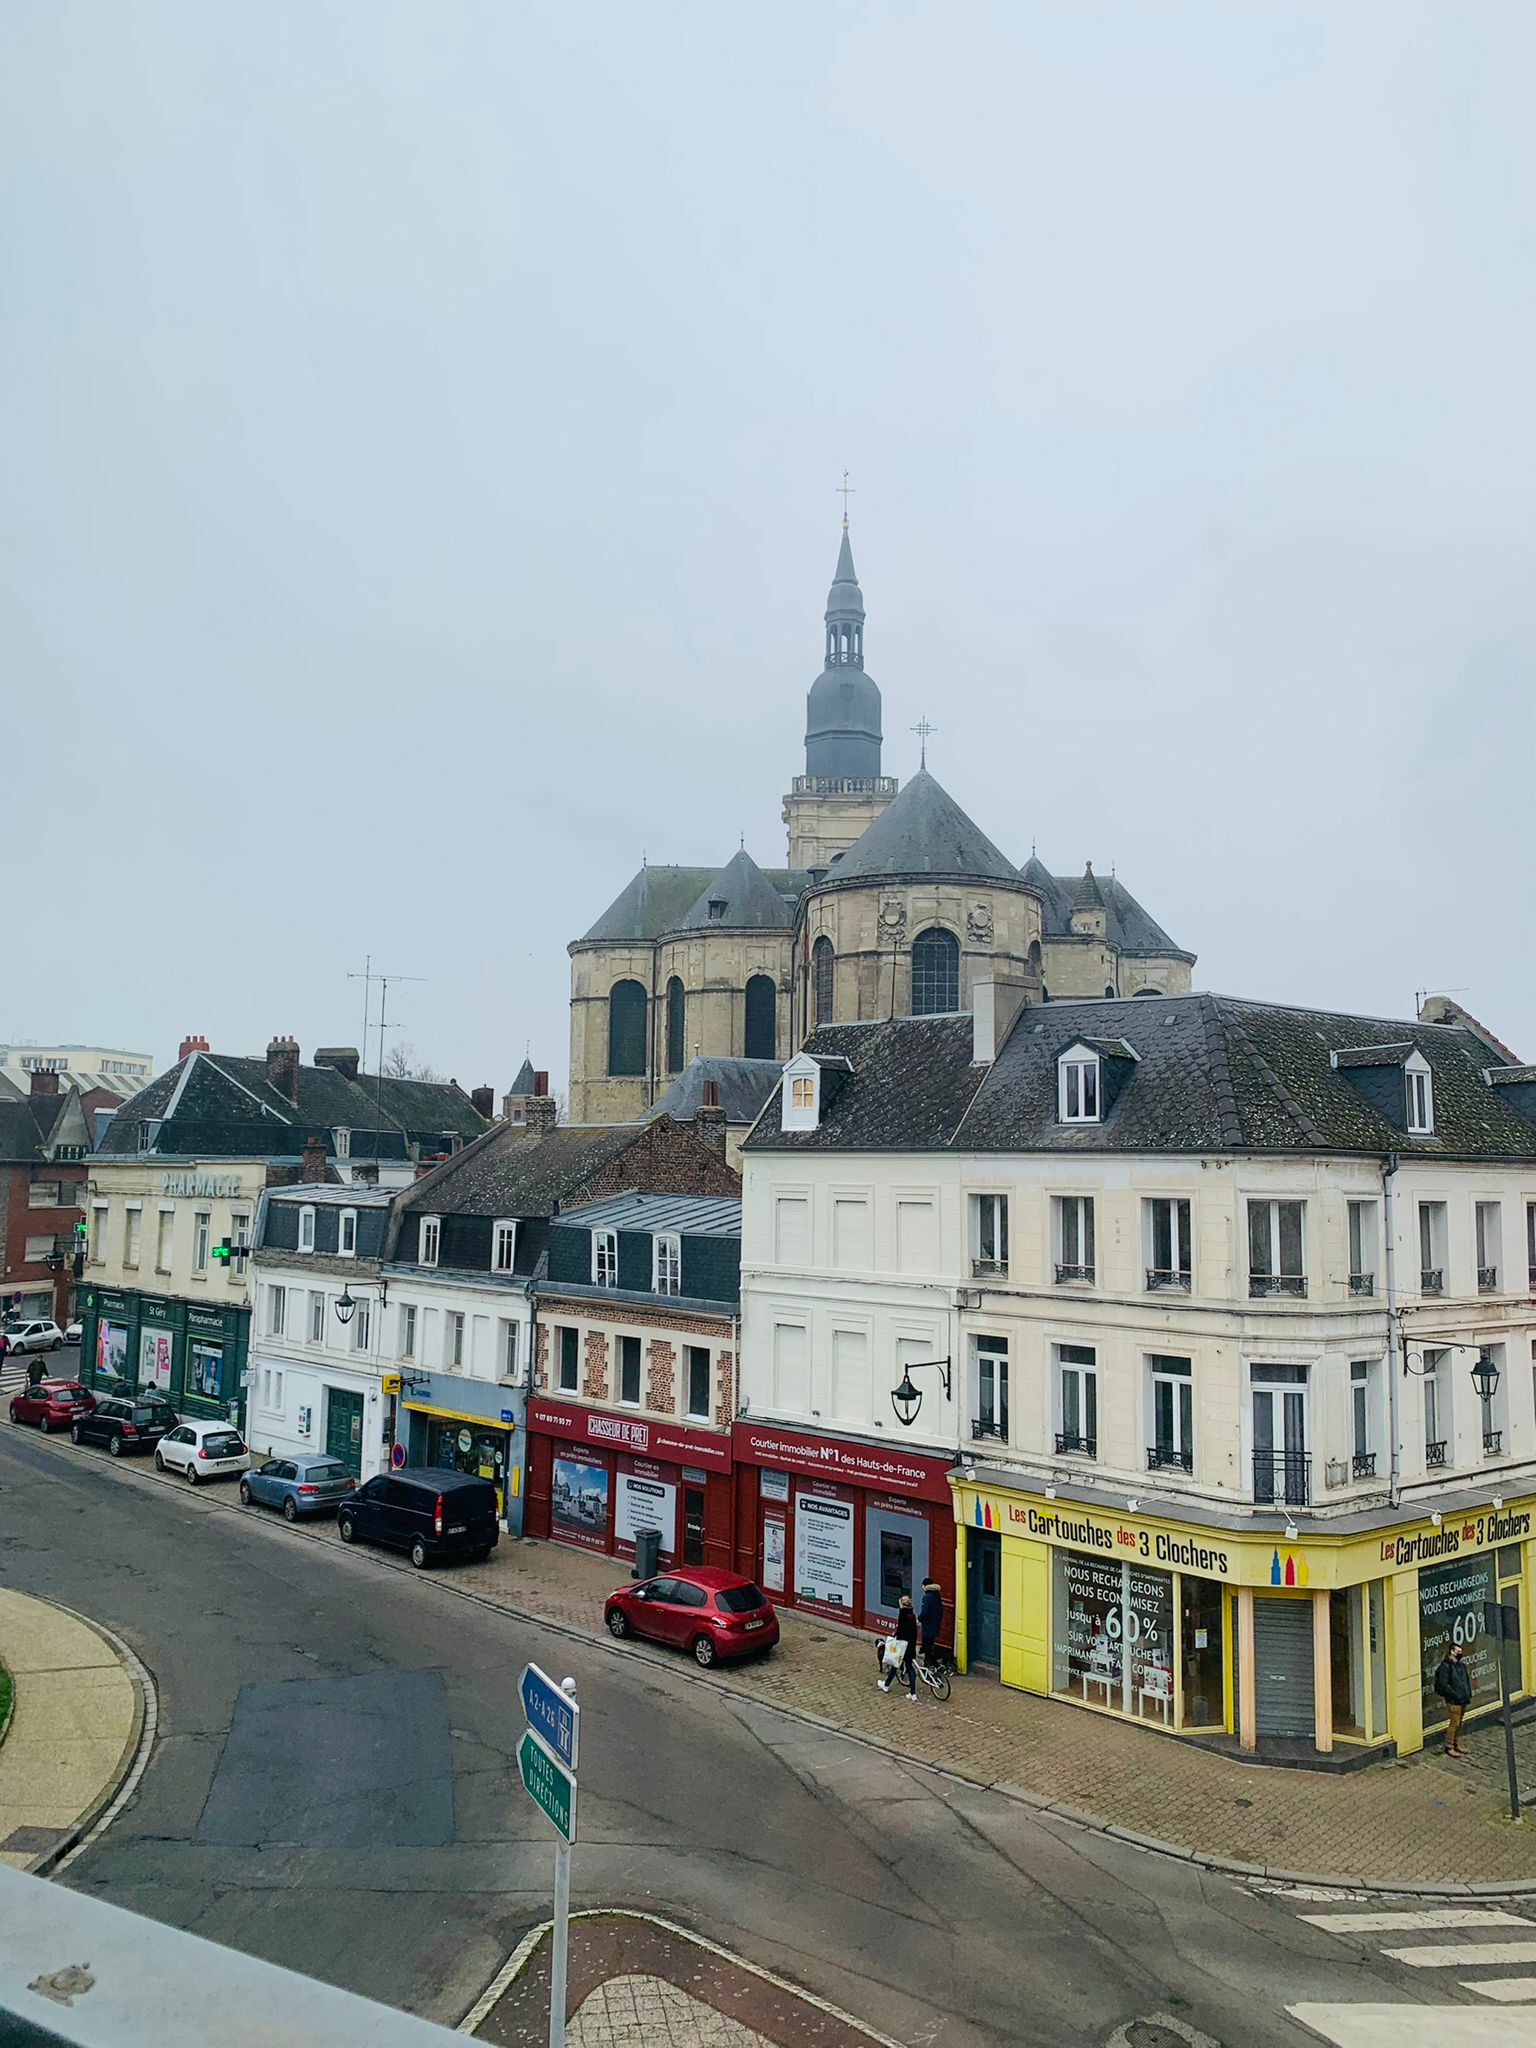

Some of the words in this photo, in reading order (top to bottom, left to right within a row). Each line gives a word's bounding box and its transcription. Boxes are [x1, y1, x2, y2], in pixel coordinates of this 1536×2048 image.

[162, 1172, 240, 1197] PHARMACIE
[103, 1299, 124, 1309] Pharmacie
[149, 1306, 155, 1315] St
[155, 1306, 166, 1318] Géry
[188, 1312, 223, 1327] Parapharmacie
[590, 1418, 621, 1439] CHASSEUR
[622, 1424, 630, 1440] DE
[631, 1424, 647, 1444] PRÊT
[634, 1459, 652, 1470] Courtier
[750, 1437, 779, 1451] Courtier
[779, 1442, 819, 1457] immobilier
[820, 1446, 840, 1462] N°1
[840, 1453, 856, 1466] des
[857, 1457, 926, 1479] Hauts-de-France
[807, 1503, 818, 1511] NOS
[819, 1506, 848, 1518] AVANTAGES
[1008, 1504, 1026, 1524] Les
[1028, 1508, 1113, 1549] Cartouches
[1117, 1525, 1135, 1547] des
[1139, 1531, 1149, 1557] 3
[1156, 1533, 1228, 1574] Clochers
[1380, 1541, 1395, 1561] Les
[1396, 1524, 1459, 1565] Cartouches
[1462, 1520, 1476, 1541] des
[1477, 1518, 1484, 1546] 3
[1487, 1509, 1531, 1543] Clochers
[1064, 1565, 1090, 1581] NOUS
[1092, 1572, 1165, 1598] RECHARGEONS
[1068, 1582, 1095, 1599] VOUS
[1419, 1585, 1439, 1600] NOUS
[1440, 1572, 1489, 1595] RECHARGEONS
[1423, 1600, 1442, 1616] VOUS
[1444, 1588, 1486, 1610] ECONOMISEZ
[1066, 1607, 1101, 1626] jusqu'à
[1068, 1630, 1085, 1644] SUR
[1423, 1630, 1450, 1651] jusqu'à
[530, 1745, 554, 1786] TOUTES
[529, 1768, 568, 1829] DIRECTIONS
